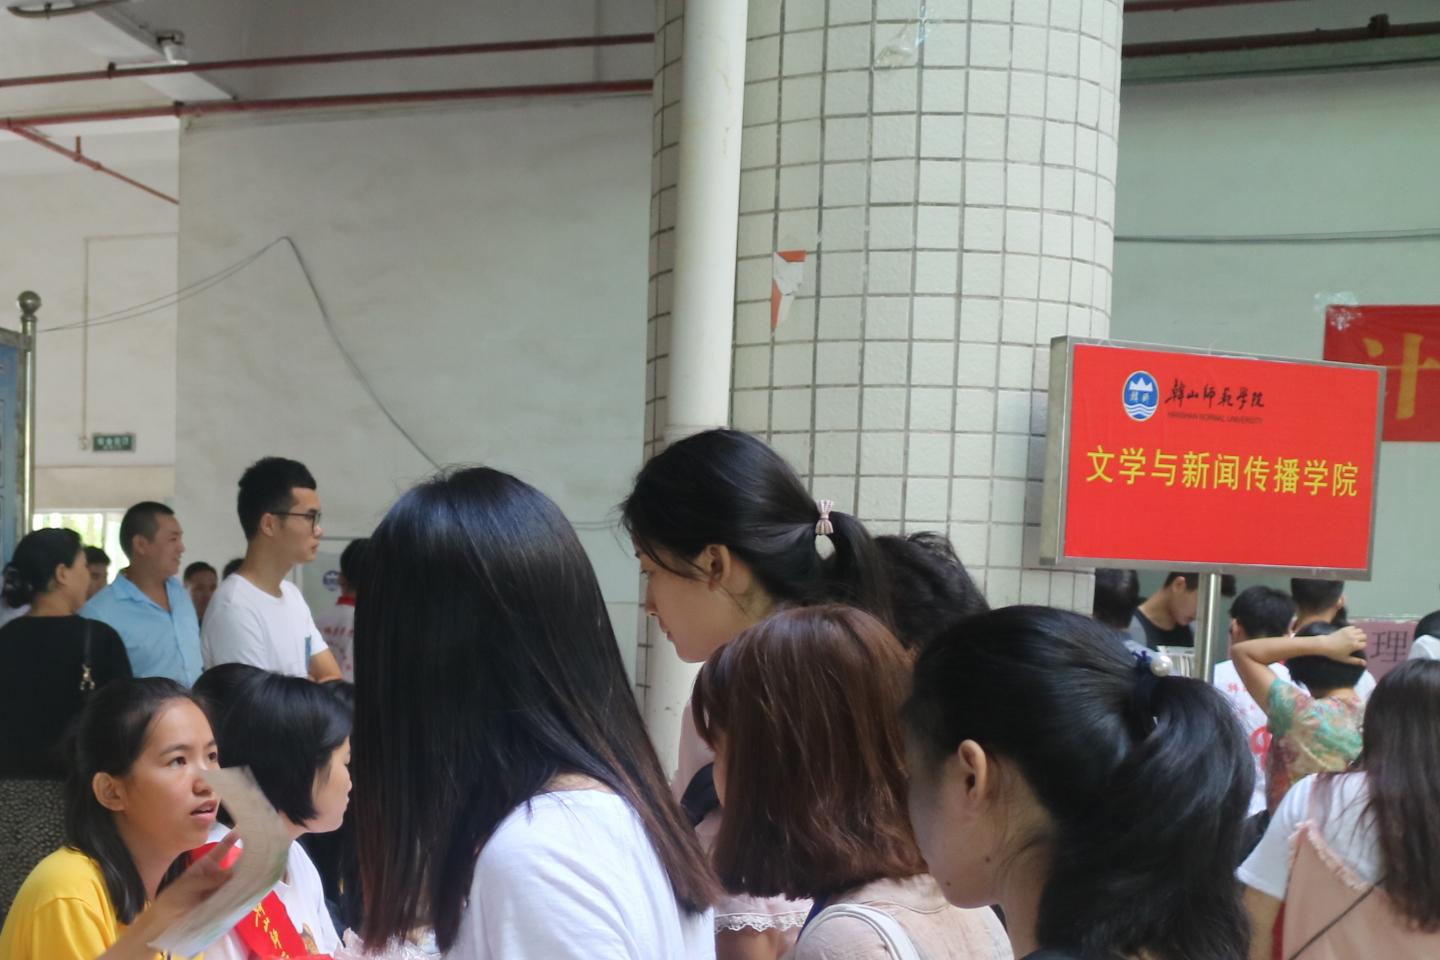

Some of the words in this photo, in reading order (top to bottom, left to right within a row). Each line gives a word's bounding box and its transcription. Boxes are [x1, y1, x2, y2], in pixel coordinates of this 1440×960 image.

[1085, 444, 1359, 498] 文学与新闻传播学院
